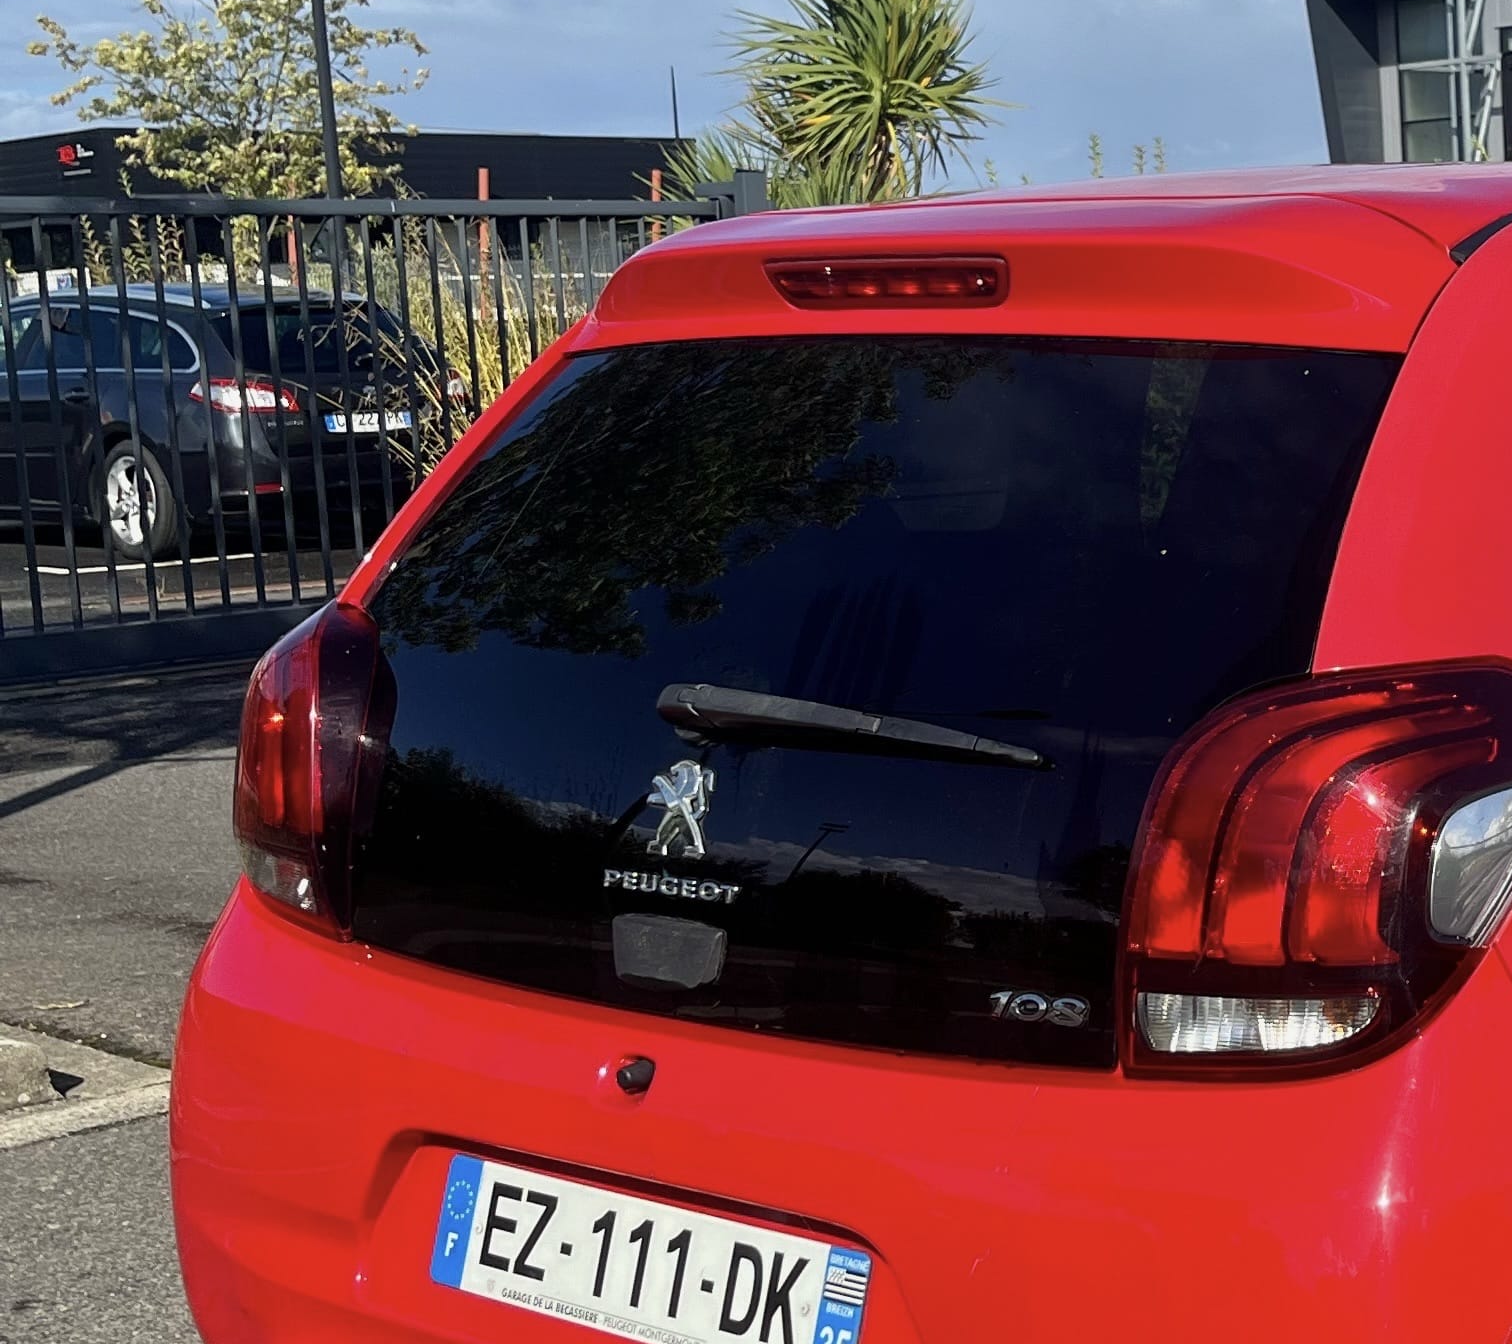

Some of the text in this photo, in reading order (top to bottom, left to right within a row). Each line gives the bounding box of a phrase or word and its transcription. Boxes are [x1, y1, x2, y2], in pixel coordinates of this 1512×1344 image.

[603, 868, 742, 904] PEUGEOT
[989, 990, 1089, 1027] 108
[444, 1232, 459, 1257] F
[501, 1287, 532, 1305] GARAGE
[532, 1296, 544, 1308] DE
[544, 1301, 554, 1311] LA
[603, 1316, 639, 1335] PEUGEOT
